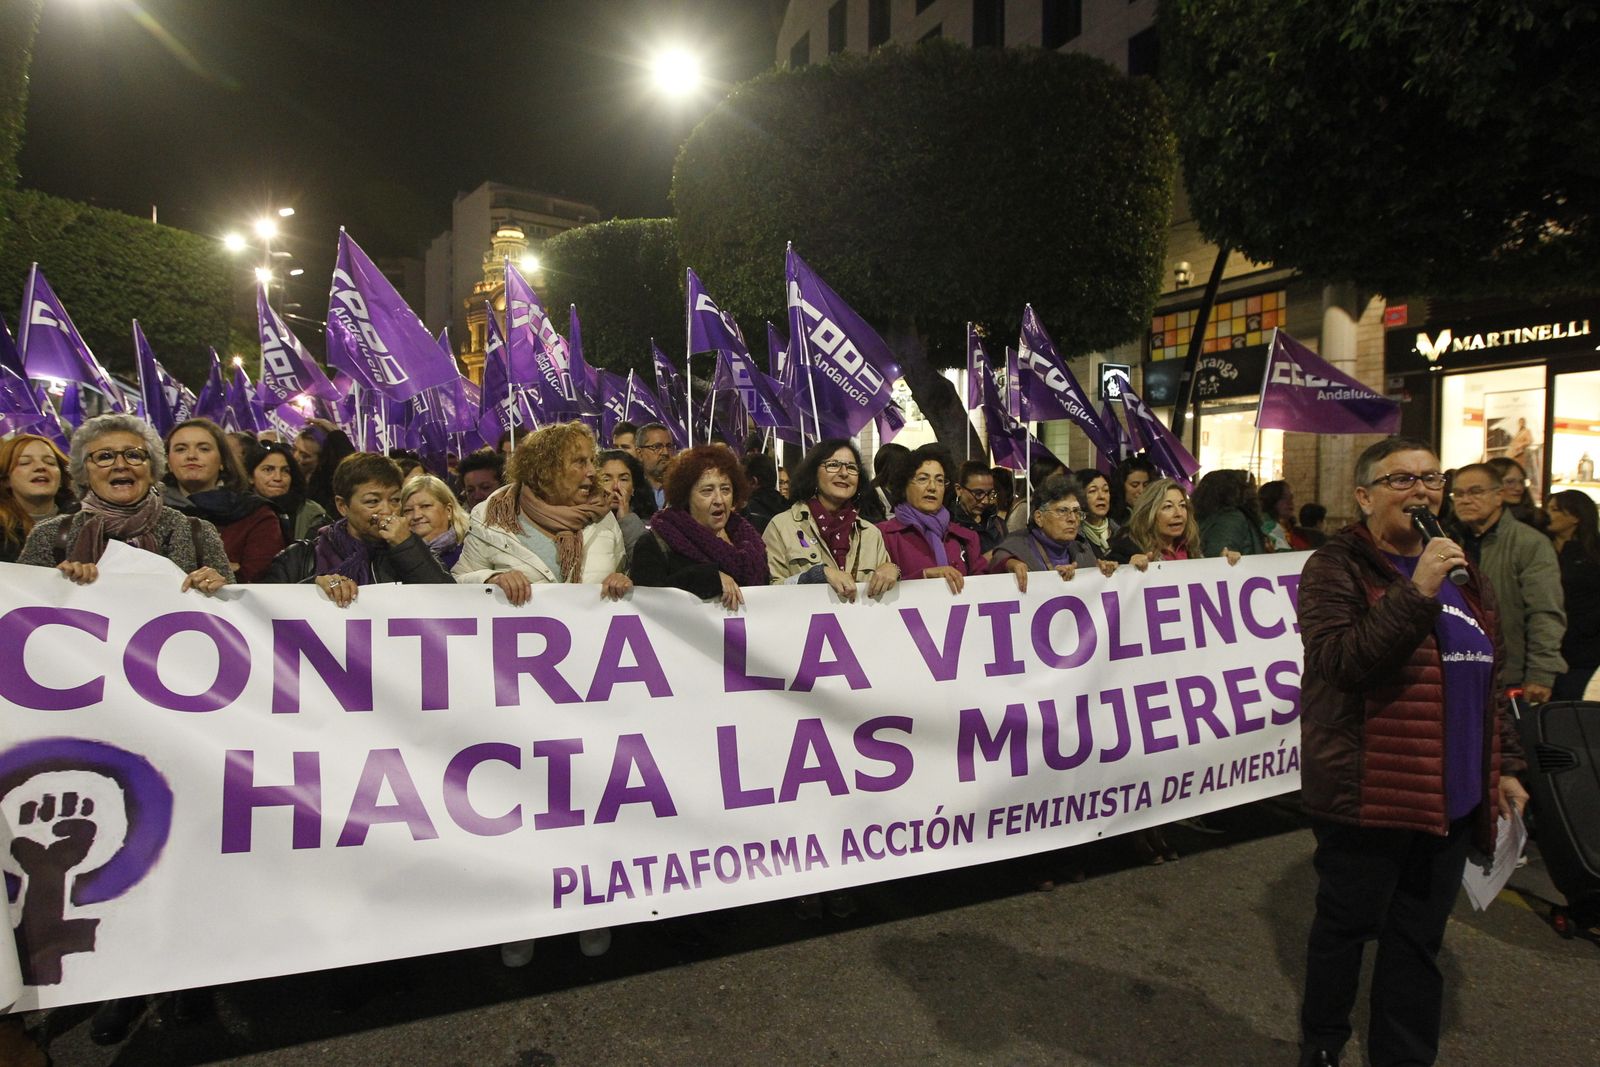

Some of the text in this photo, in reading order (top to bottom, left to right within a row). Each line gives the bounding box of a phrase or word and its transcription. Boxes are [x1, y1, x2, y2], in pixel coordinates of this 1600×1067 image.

[814, 353, 869, 406] Andalucía
[1452, 319, 1591, 352] MARTINELLI
[0, 573, 1302, 714] CONTRA LA VIOLENCI
[221, 660, 1302, 854] HACIA LAS MUJERES
[552, 739, 1301, 909] PLATAFORMA ACCIÓN FEMINISTA DE ALMERÍA
